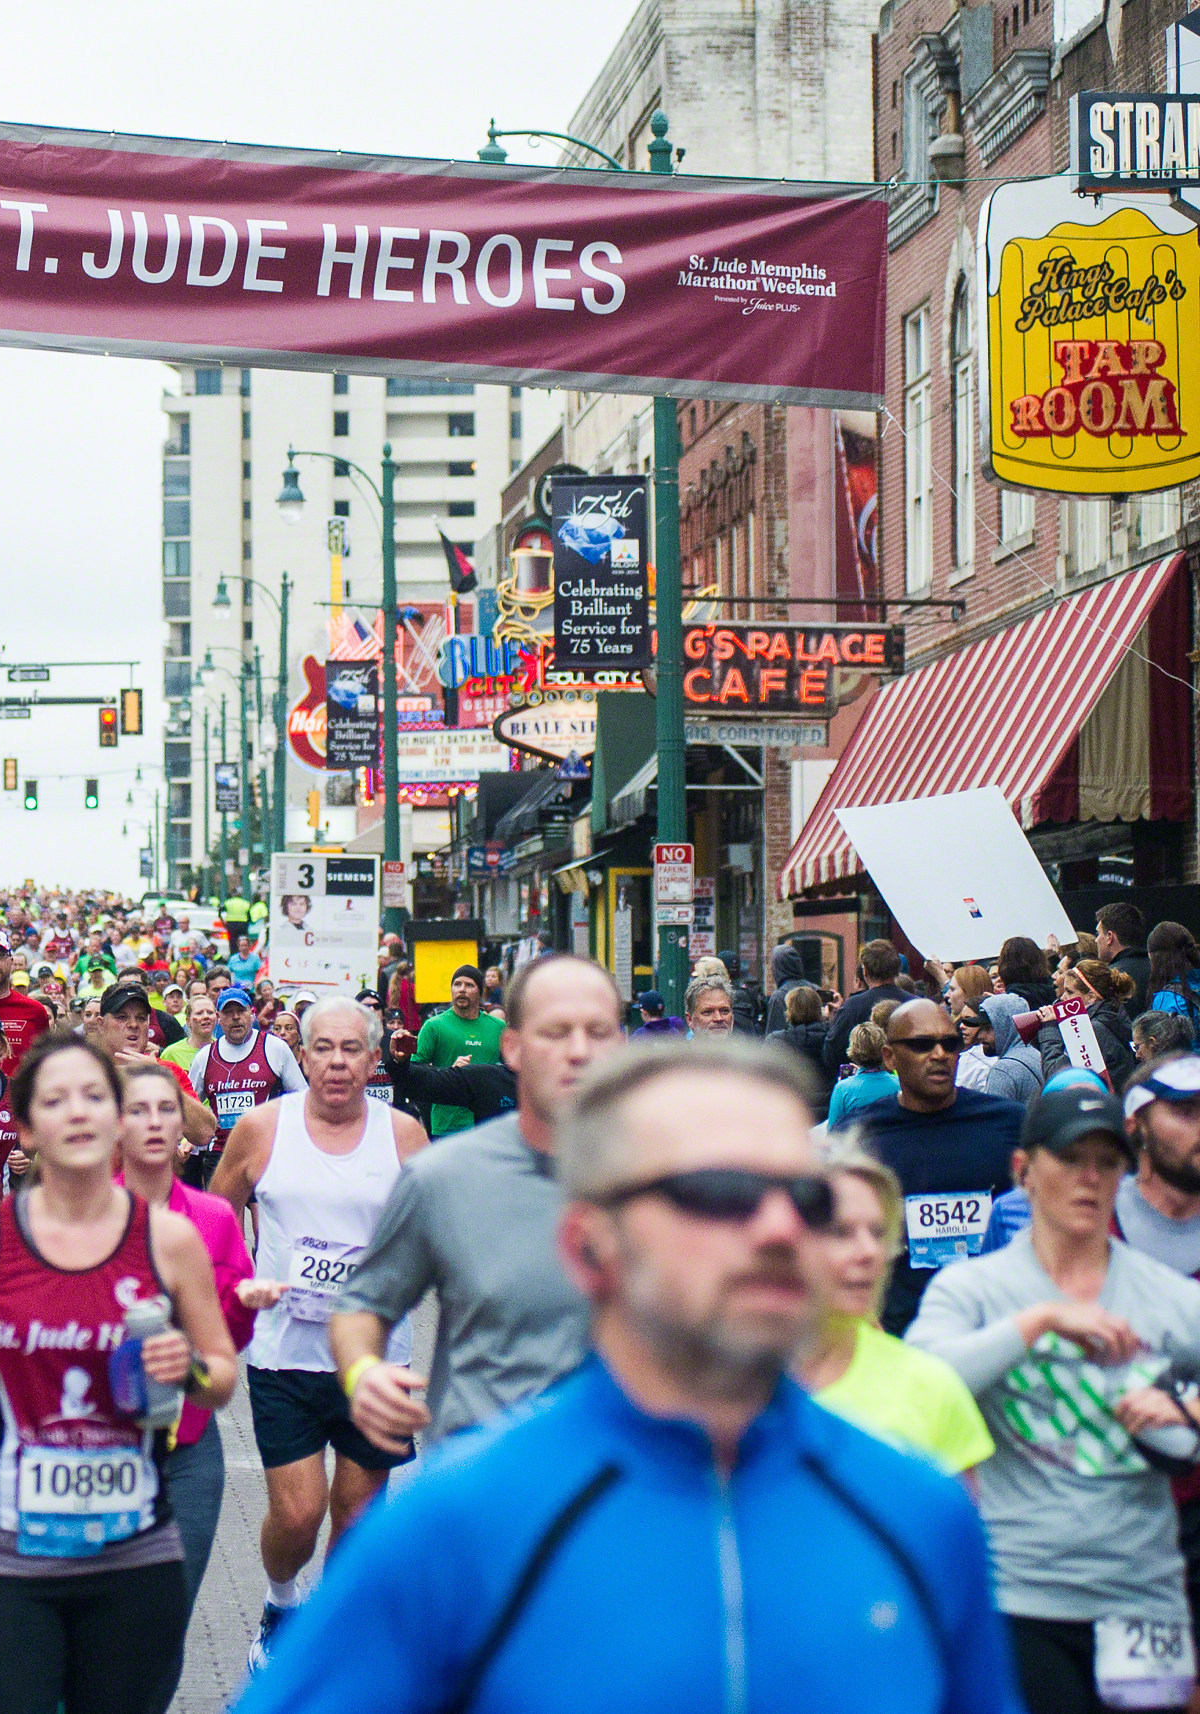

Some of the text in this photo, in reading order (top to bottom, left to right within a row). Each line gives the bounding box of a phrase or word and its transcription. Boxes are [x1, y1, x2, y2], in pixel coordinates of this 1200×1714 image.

[82, 209, 287, 293] JUDE
[316, 223, 627, 315] HEROES
[689, 254, 827, 281] St. Jude Memphis
[761, 277, 837, 297] Weekend
[1030, 256, 1114, 299] Kings
[714, 295, 740, 304] Presented
[742, 298, 775, 316] Juice
[1015, 270, 1187, 333] Palace Cafe's
[1055, 340, 1167, 385] TAP
[1011, 378, 1175, 434] ROOM
[577, 488, 645, 529] 75th
[558, 579, 643, 601] Celebrating
[571, 598, 633, 616] Brilliant
[562, 617, 643, 636] Service for
[570, 638, 634, 654] 75 Years
[749, 631, 886, 665] PALACE
[465, 676, 515, 697] CIT
[544, 671, 584, 684] SOUL
[683, 667, 828, 704] CAFE
[328, 717, 377, 730] Celebrating
[510, 721, 560, 736] BEALE
[330, 739, 376, 751] Service for
[335, 729, 371, 741] Brilliant
[335, 751, 371, 761] 75 Years
[662, 847, 686, 861] NO
[297, 864, 315, 889] 3
[327, 872, 374, 882] SIEMENS
[1056, 1004, 1067, 1018] I
[1080, 1045, 1092, 1068] Jud
[217, 1080, 240, 1092] Jude
[241, 1078, 267, 1089] Hero
[218, 1095, 253, 1109] 11729
[919, 1199, 982, 1228] 8542
[935, 1225, 968, 1235] HAROLD
[23, 1320, 93, 1355] Jude
[30, 1462, 136, 1498] 10890
